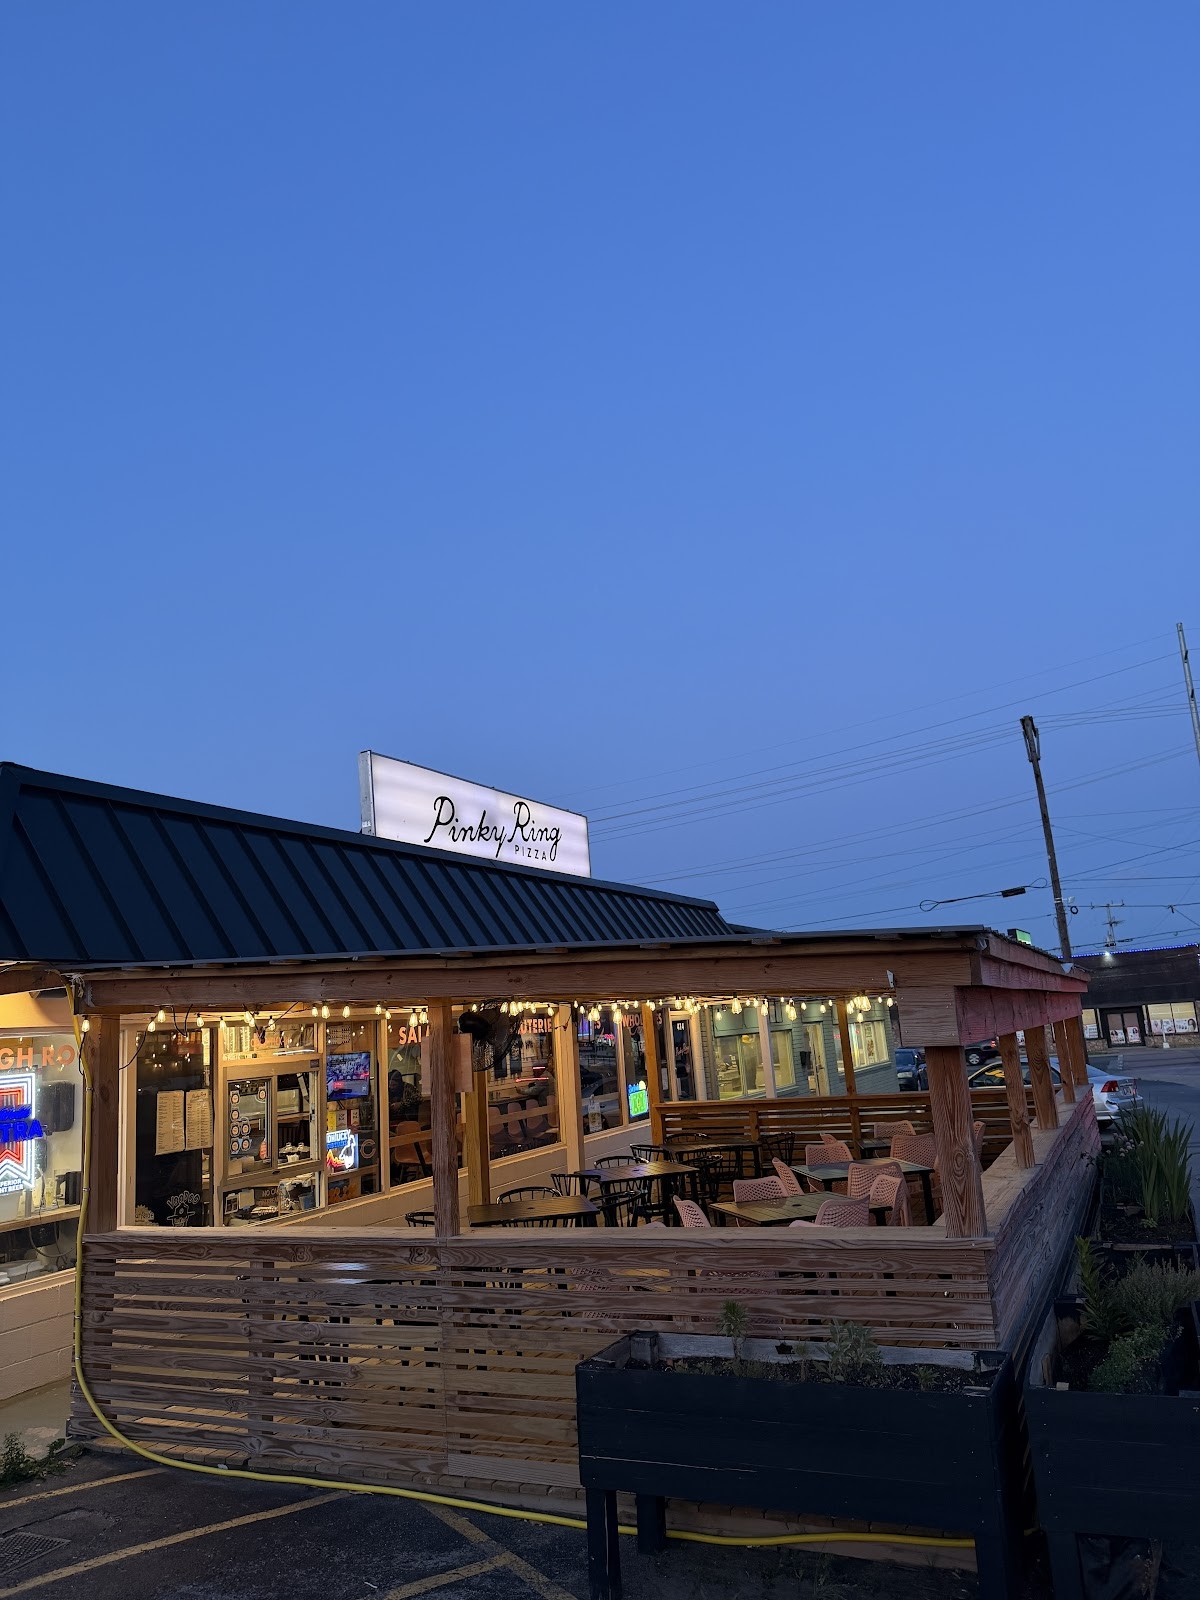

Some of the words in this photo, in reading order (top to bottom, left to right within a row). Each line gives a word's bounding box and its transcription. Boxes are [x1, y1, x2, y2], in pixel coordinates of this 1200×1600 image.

[424, 796, 507, 858] Pinky
[508, 801, 563, 862] Ring
[515, 844, 547, 860] PIZZA
[517, 1018, 552, 1034] UTERIE
